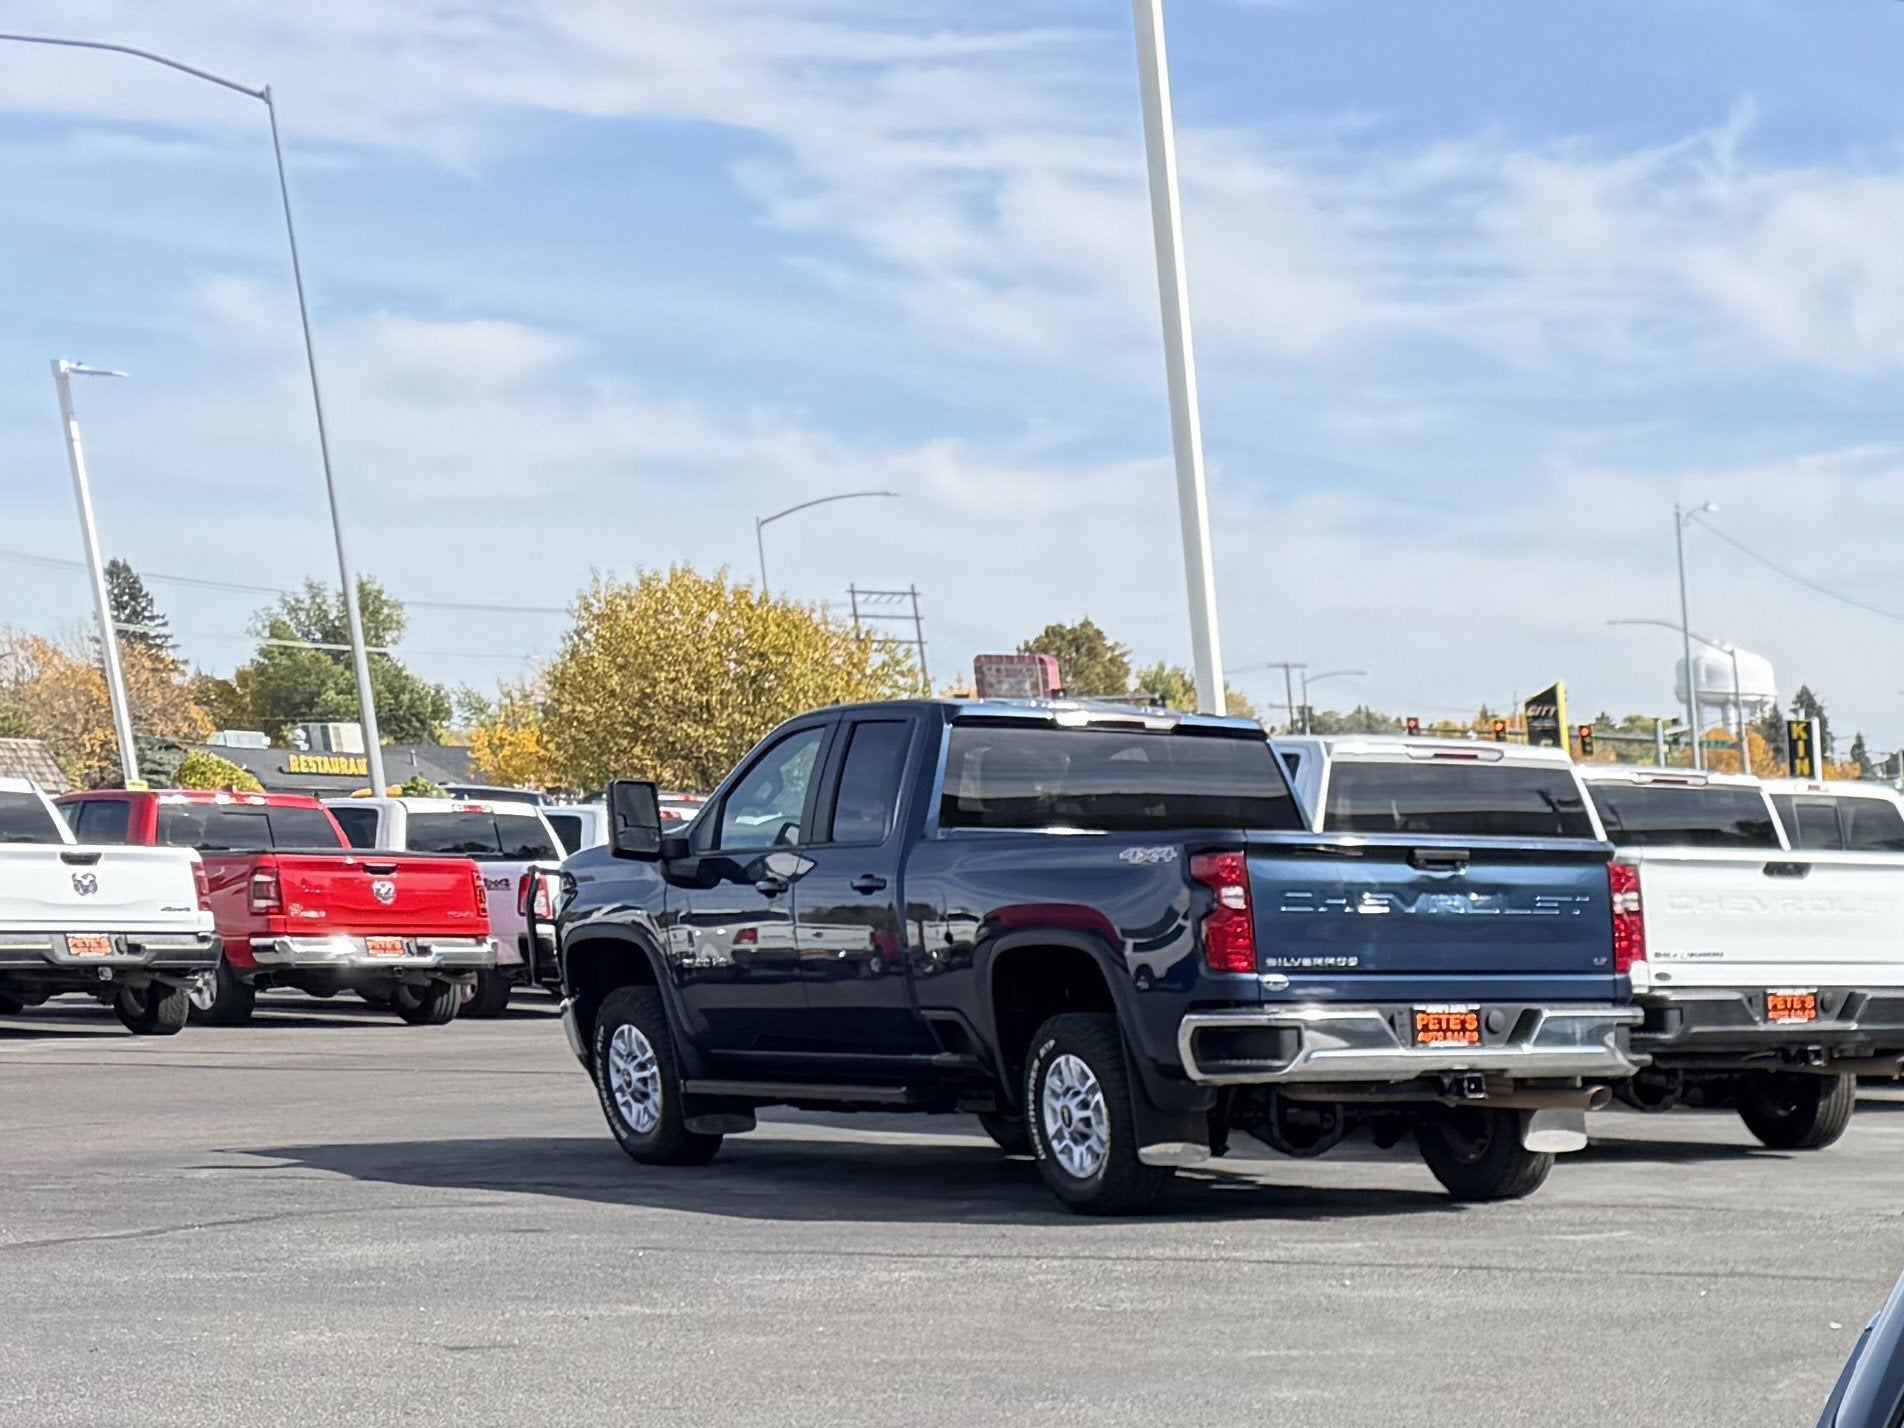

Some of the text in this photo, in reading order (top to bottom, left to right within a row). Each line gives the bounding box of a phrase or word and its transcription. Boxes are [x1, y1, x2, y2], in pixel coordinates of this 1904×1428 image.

[1791, 722, 1810, 776] KIN
[289, 754, 368, 774] RESTAURAN
[1281, 892, 1590, 914] CHEVROLET
[1416, 1013, 1478, 1030] PETE'S
